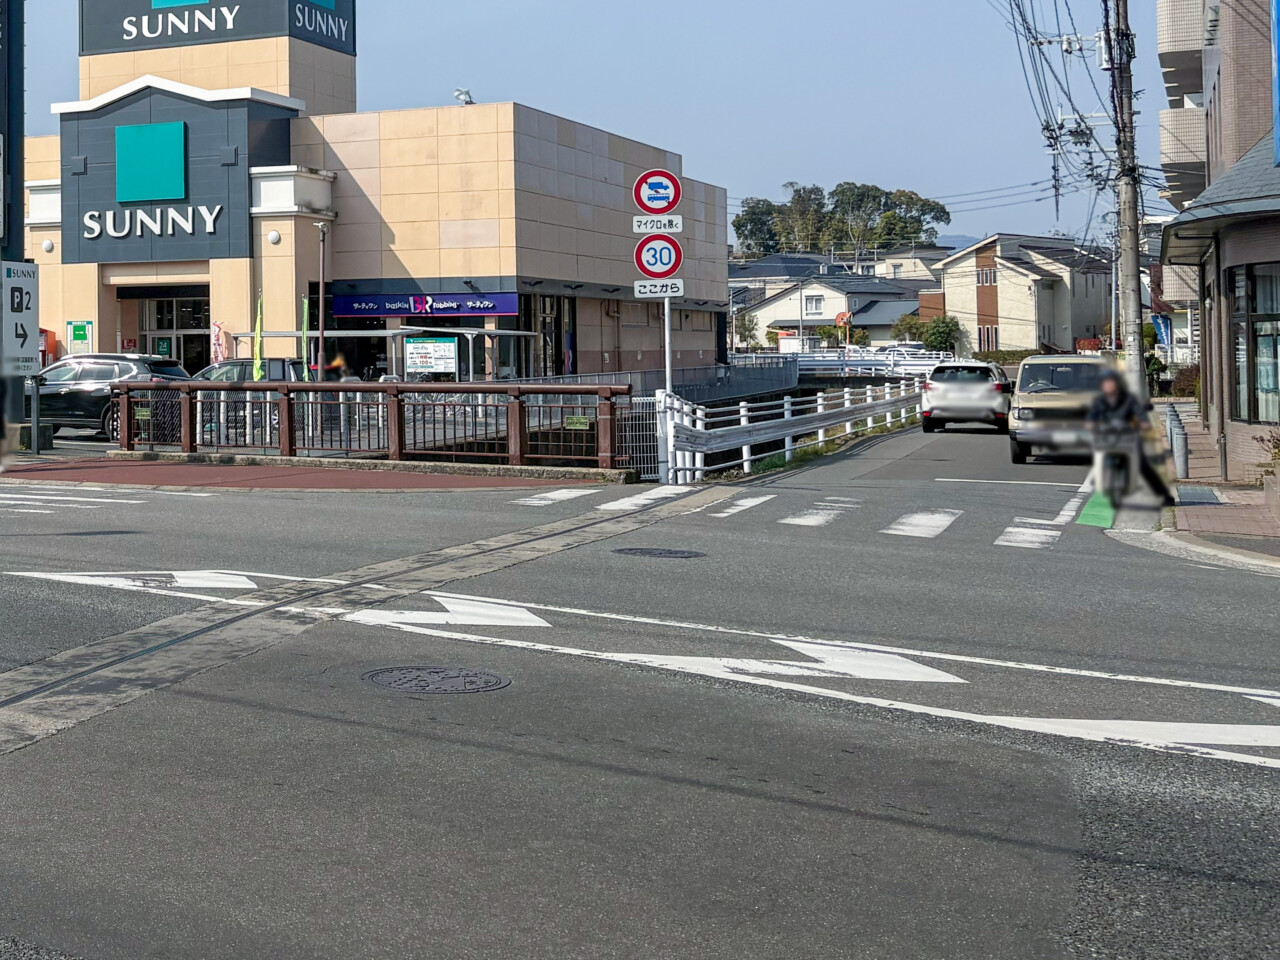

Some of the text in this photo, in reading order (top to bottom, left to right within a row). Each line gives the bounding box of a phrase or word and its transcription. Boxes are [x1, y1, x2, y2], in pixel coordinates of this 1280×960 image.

[122, 6, 240, 40] SUNNY
[295, 4, 348, 42] SUNNY
[82, 204, 223, 240] SUNNY
[636, 219, 680, 230] マイクロを除く
[646, 247, 672, 267] 30
[12, 268, 37, 280] SUNNY
[638, 282, 680, 295] ここから
[466, 300, 494, 309] サーティワン
